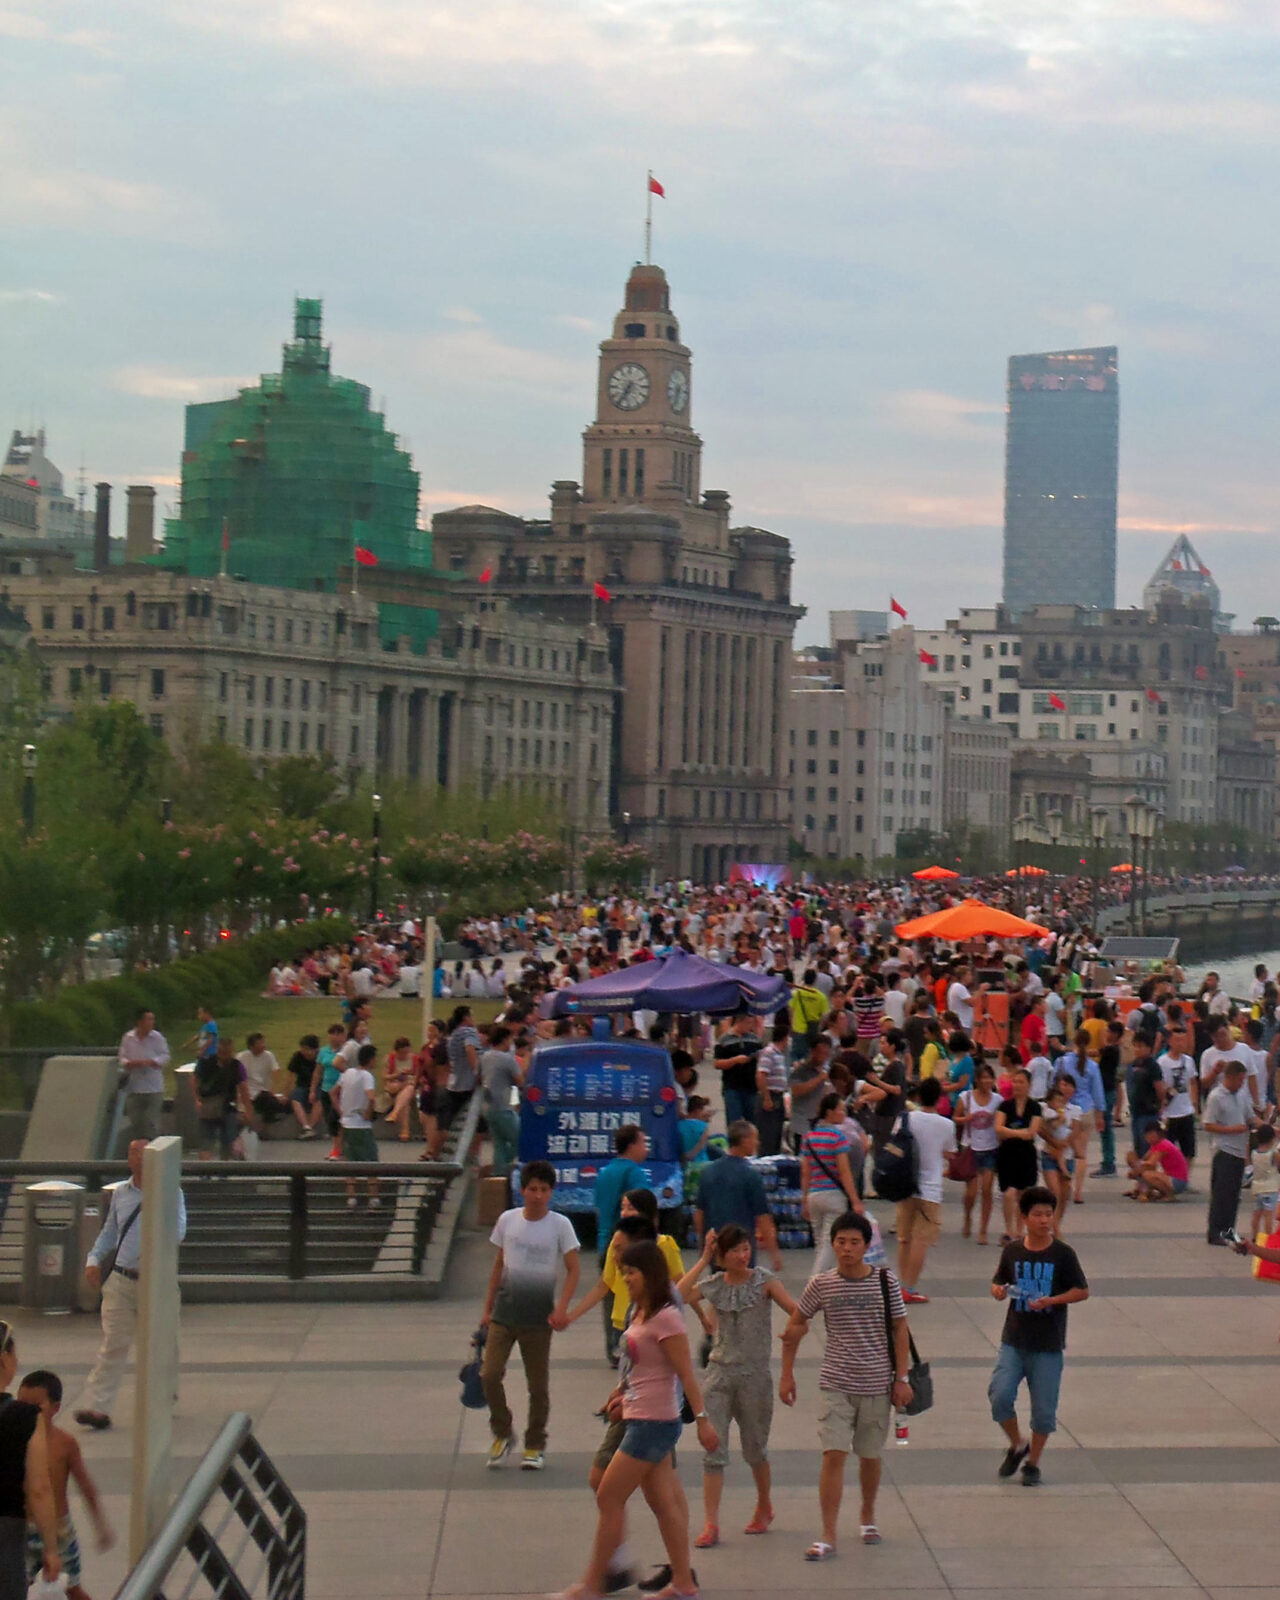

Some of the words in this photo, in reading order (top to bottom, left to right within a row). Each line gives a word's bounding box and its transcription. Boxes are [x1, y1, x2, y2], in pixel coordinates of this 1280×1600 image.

[558, 1111, 641, 1130] 外滩饮料
[547, 1134, 652, 1153] 流动服
